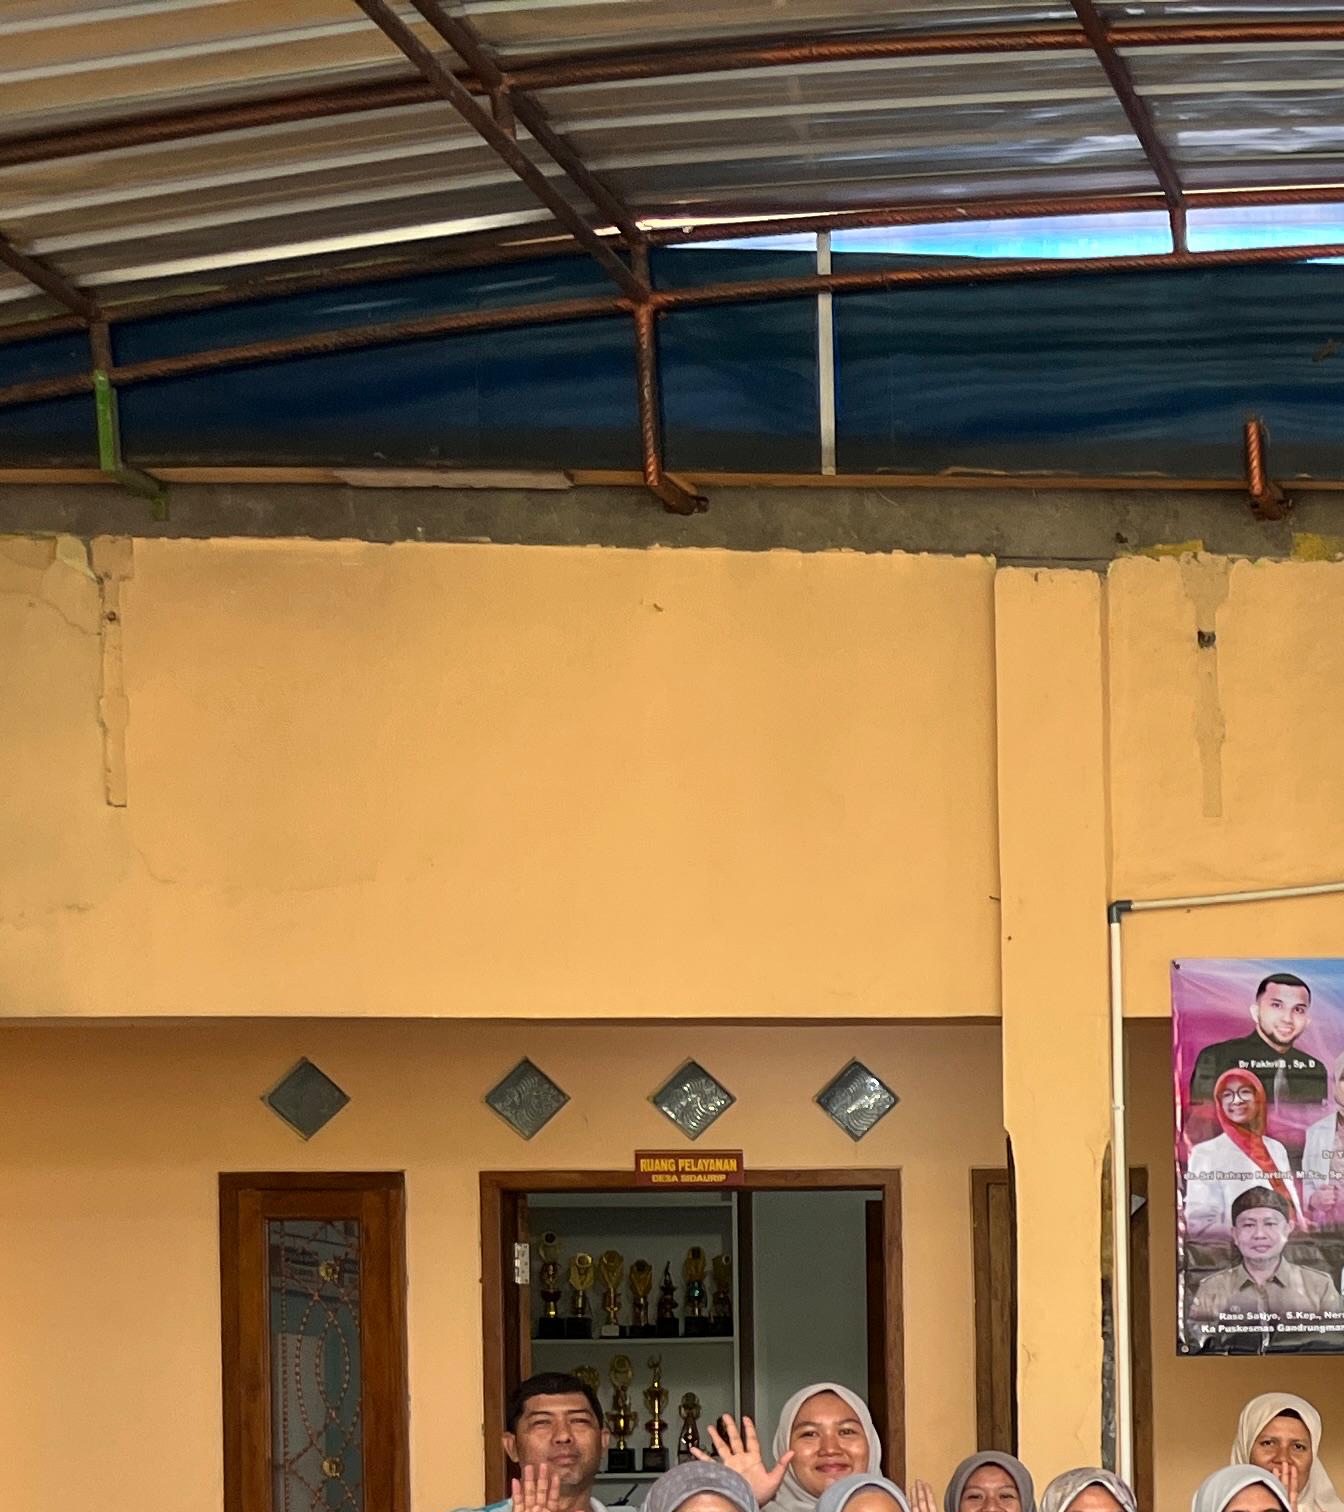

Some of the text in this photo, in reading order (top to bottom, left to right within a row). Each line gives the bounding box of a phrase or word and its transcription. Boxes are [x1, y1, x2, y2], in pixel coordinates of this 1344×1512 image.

[1238, 1060, 1249, 1068] Dr
[1322, 1151, 1334, 1159] Dr
[640, 1158, 738, 1172] RUANG PELAYANAN
[652, 1174, 726, 1183] DESA SIDAURIP
[1200, 1171, 1214, 1180] Sri
[1216, 1171, 1253, 1182] Rahayu
[1201, 1325, 1216, 1333] Ka
[1218, 1324, 1274, 1333] Puskesmas
